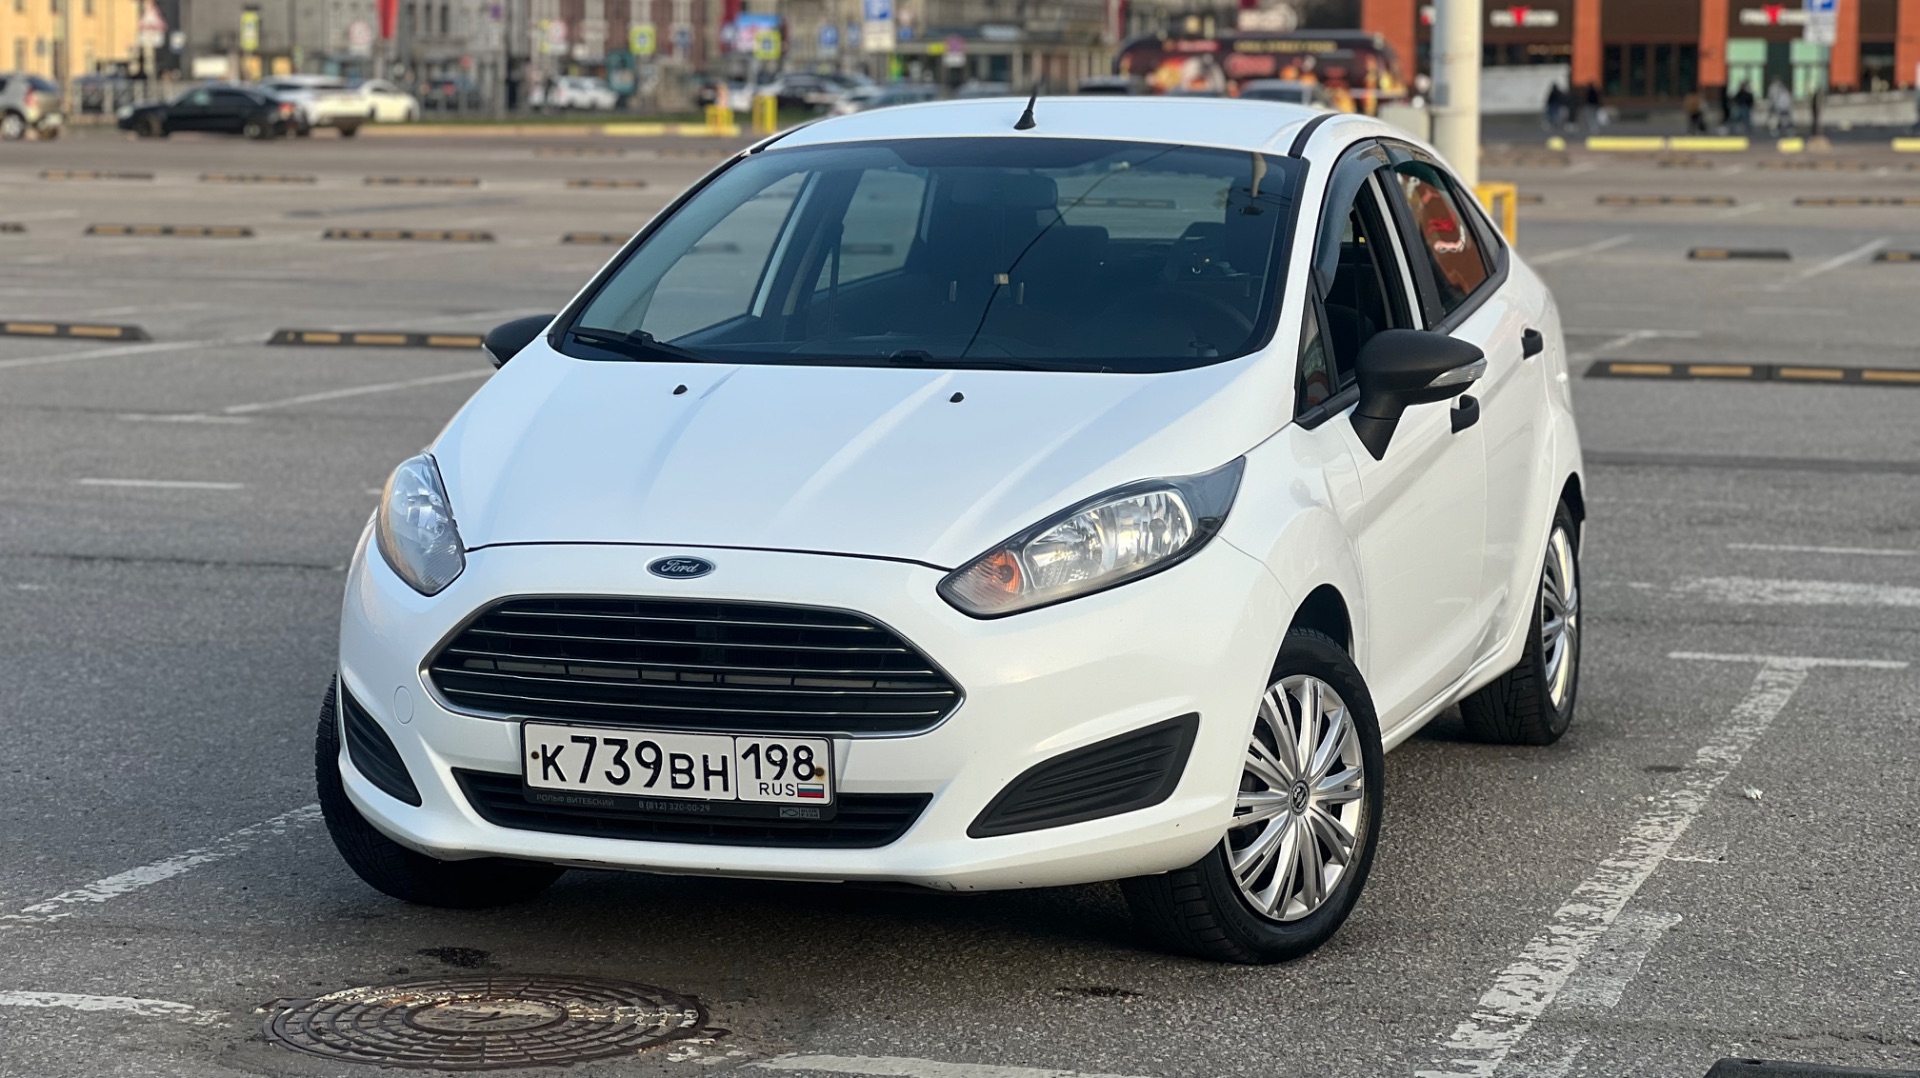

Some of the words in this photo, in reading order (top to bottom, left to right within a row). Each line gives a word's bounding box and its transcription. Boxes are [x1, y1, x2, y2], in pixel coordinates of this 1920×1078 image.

[661, 560, 699, 573] Ford
[741, 743, 815, 781] 198
[759, 781, 795, 797] RUS
[536, 794, 565, 804] РОЛЬФ
[566, 795, 614, 807] ВИТЕБСКИЙ
[638, 801, 645, 809] 8
[645, 801, 668, 811] (812)
[669, 803, 711, 812] 320-00-29
